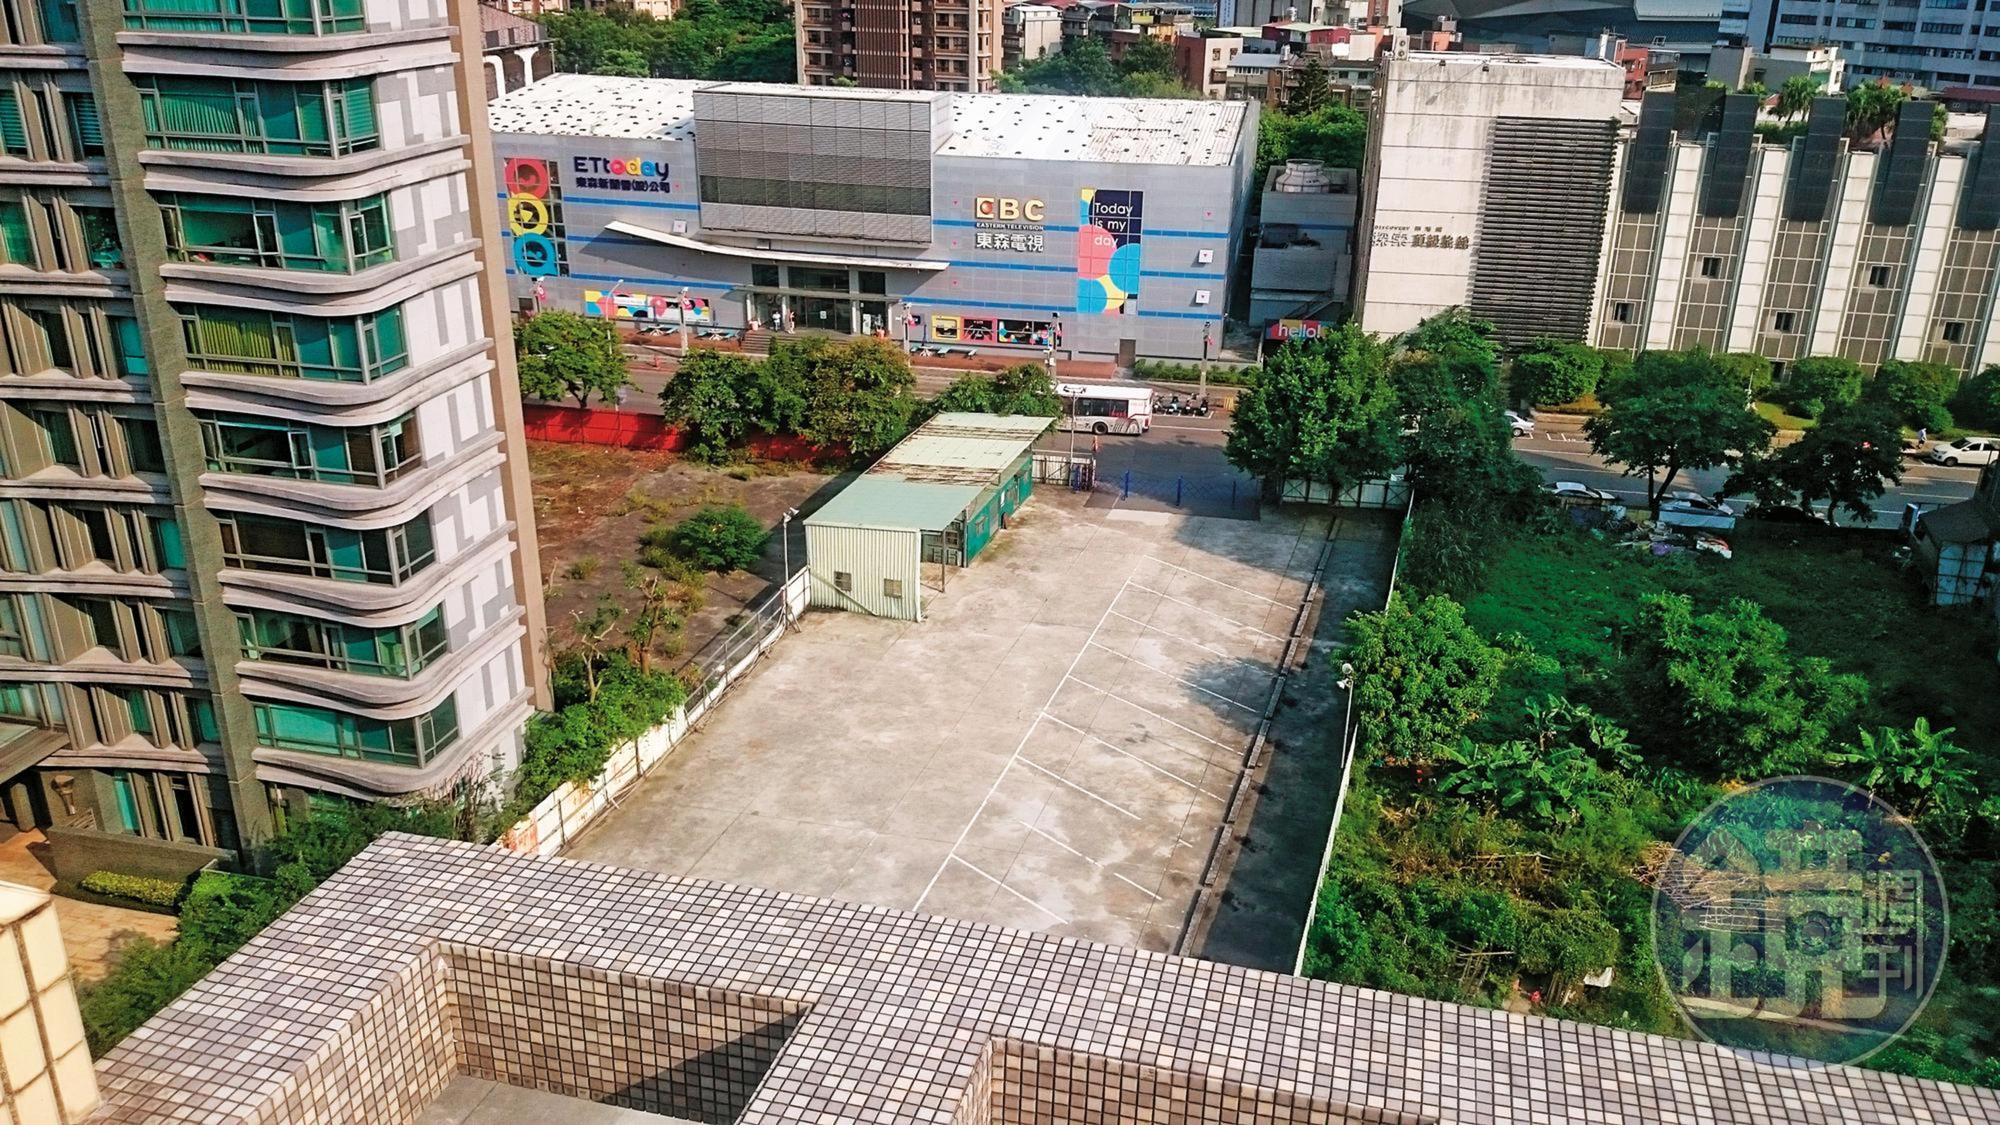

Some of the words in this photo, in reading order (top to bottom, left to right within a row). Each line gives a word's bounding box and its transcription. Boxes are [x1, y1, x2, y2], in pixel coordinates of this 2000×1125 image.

[573, 156, 669, 181] ETtoday
[976, 197, 1044, 221] EBC
[1095, 202, 1133, 216] Today
[976, 222, 1006, 230] EASTERN
[1007, 223, 1044, 231] TELEVISION
[1095, 218, 1103, 228] is
[1107, 220, 1126, 232] my
[976, 232, 1044, 252] 東森電視
[1094, 235, 1118, 248] day
